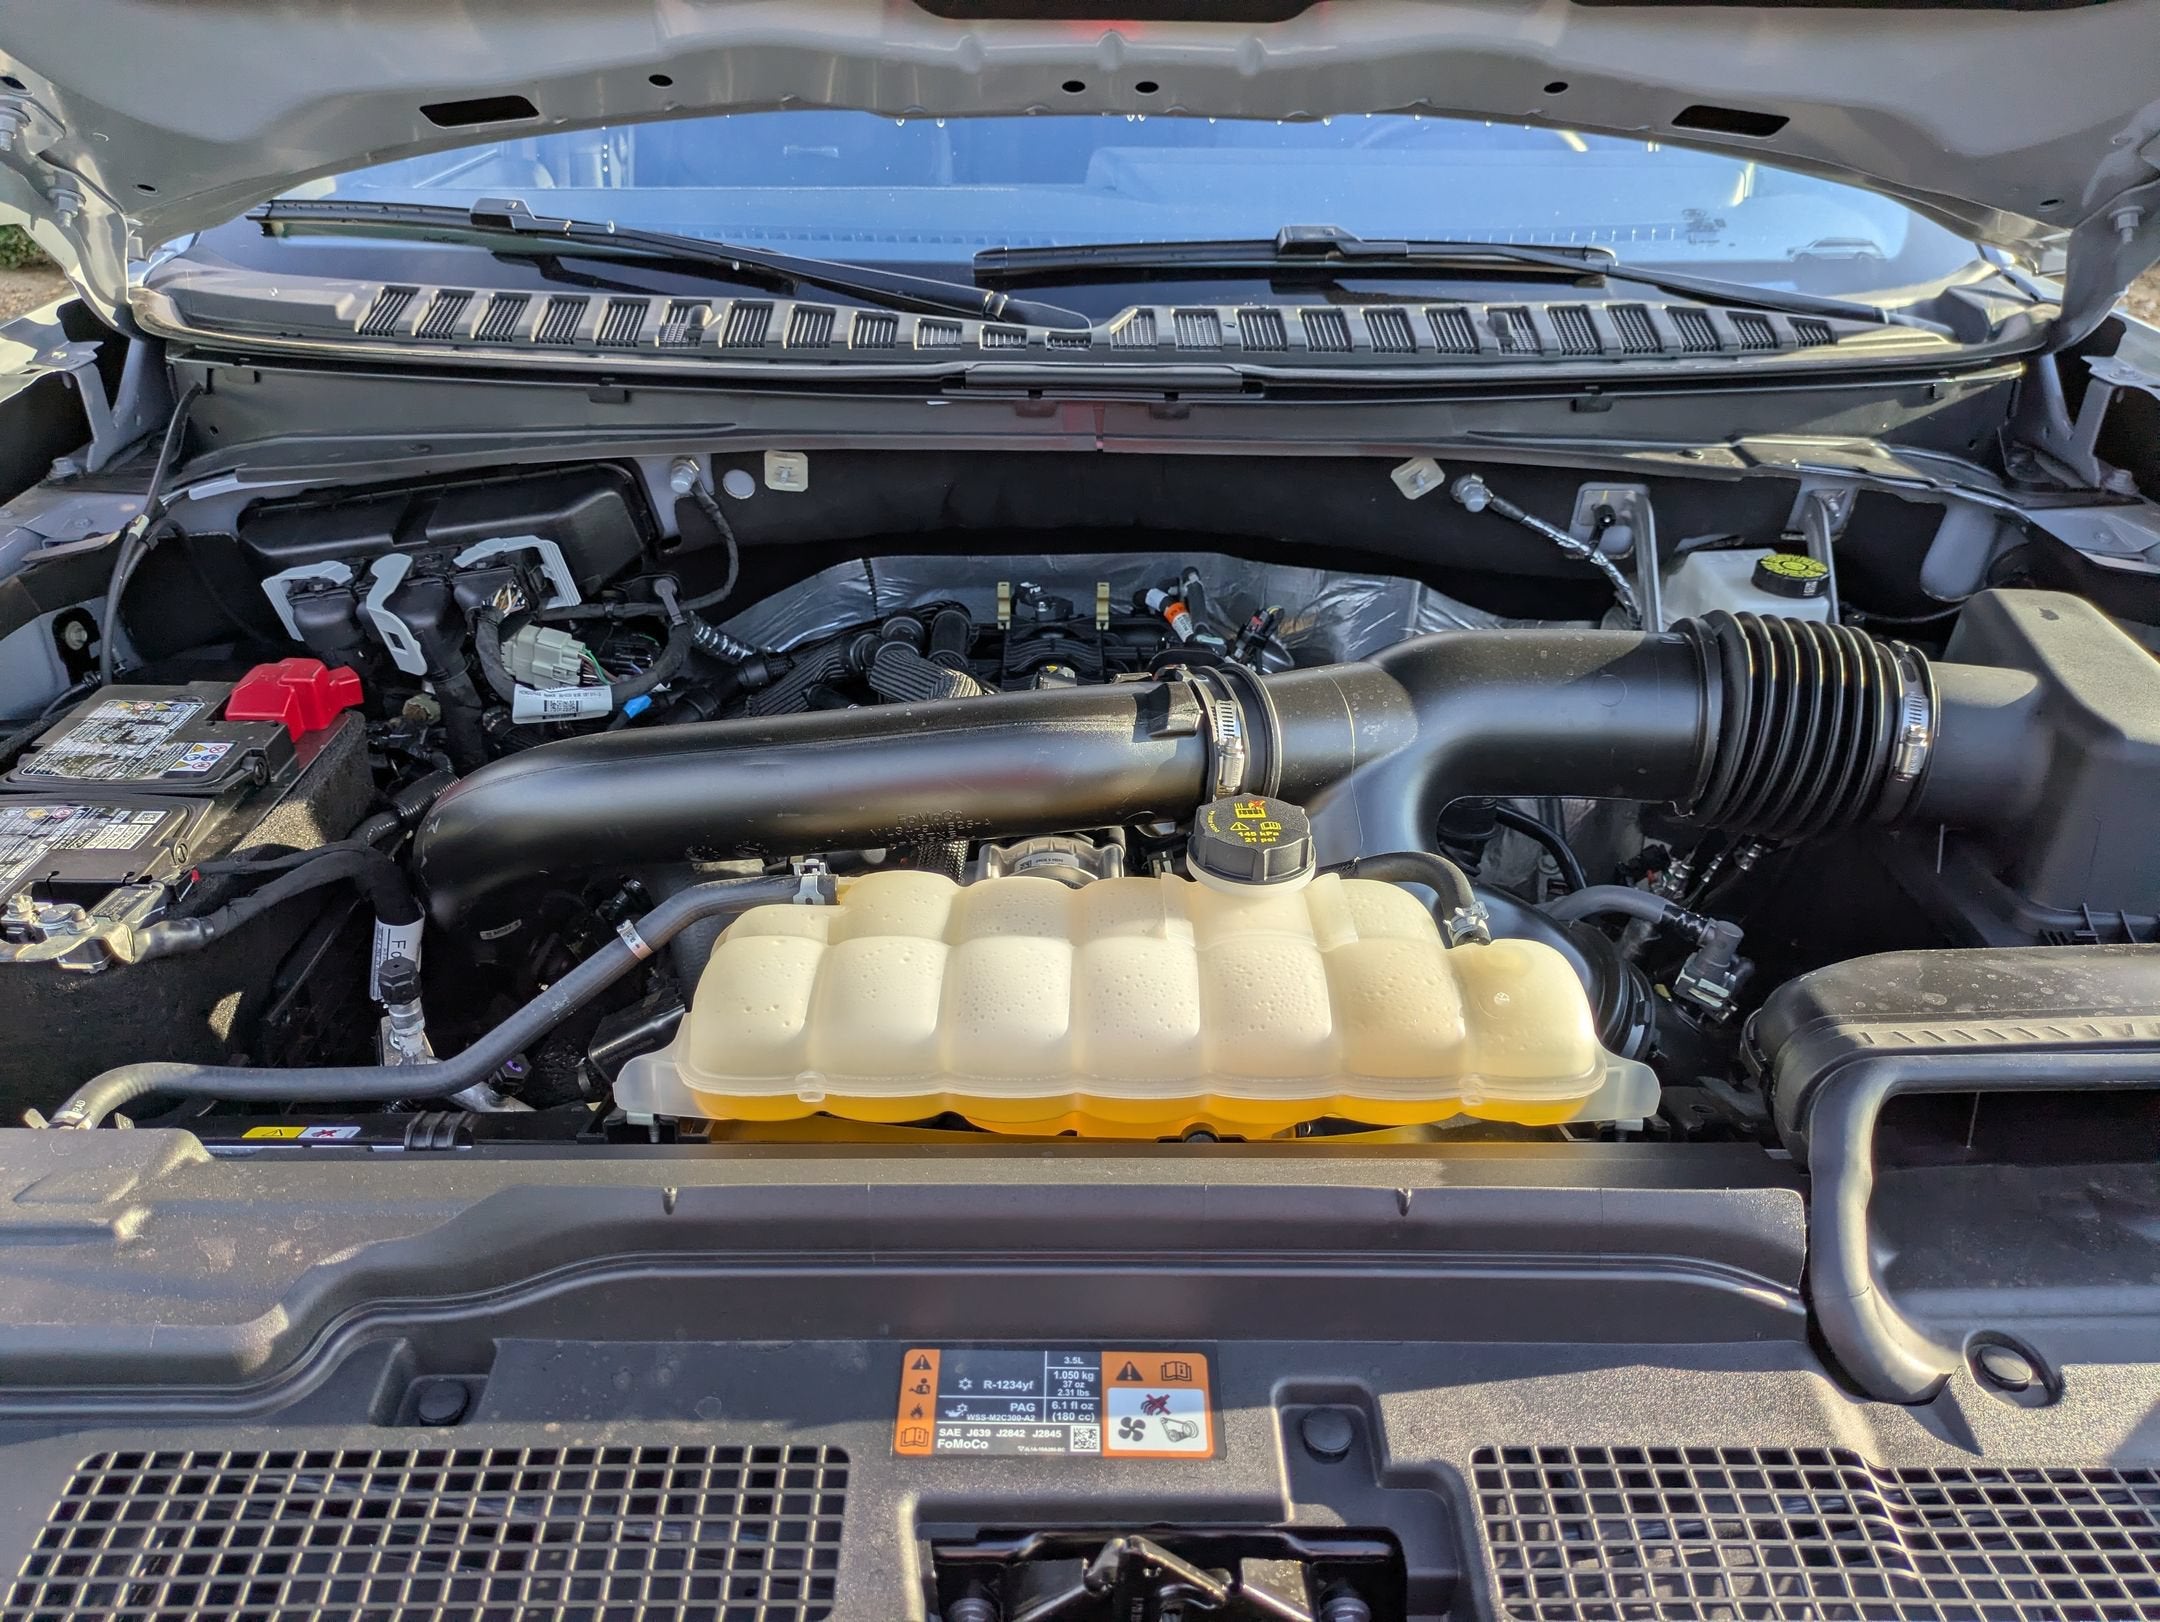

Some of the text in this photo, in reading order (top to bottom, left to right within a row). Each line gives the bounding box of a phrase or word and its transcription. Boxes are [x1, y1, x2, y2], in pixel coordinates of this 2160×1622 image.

[1063, 1356, 1084, 1364] 3.5L
[1053, 1370, 1095, 1382] 1.050 kg
[983, 1380, 1035, 1392] R-1234yf
[1076, 1389, 1090, 1397] lbs
[1010, 1402, 1036, 1412] PAG
[1051, 1401, 1067, 1410] 6.1
[1070, 1401, 1079, 1410] fl
[966, 1414, 1036, 1422] WSS-M2C300-A2
[1052, 1412, 1096, 1423] (180 cc)
[938, 1428, 1062, 1438] SAE J639 J2842 J2845
[937, 1438, 989, 1449] FoMoCo
